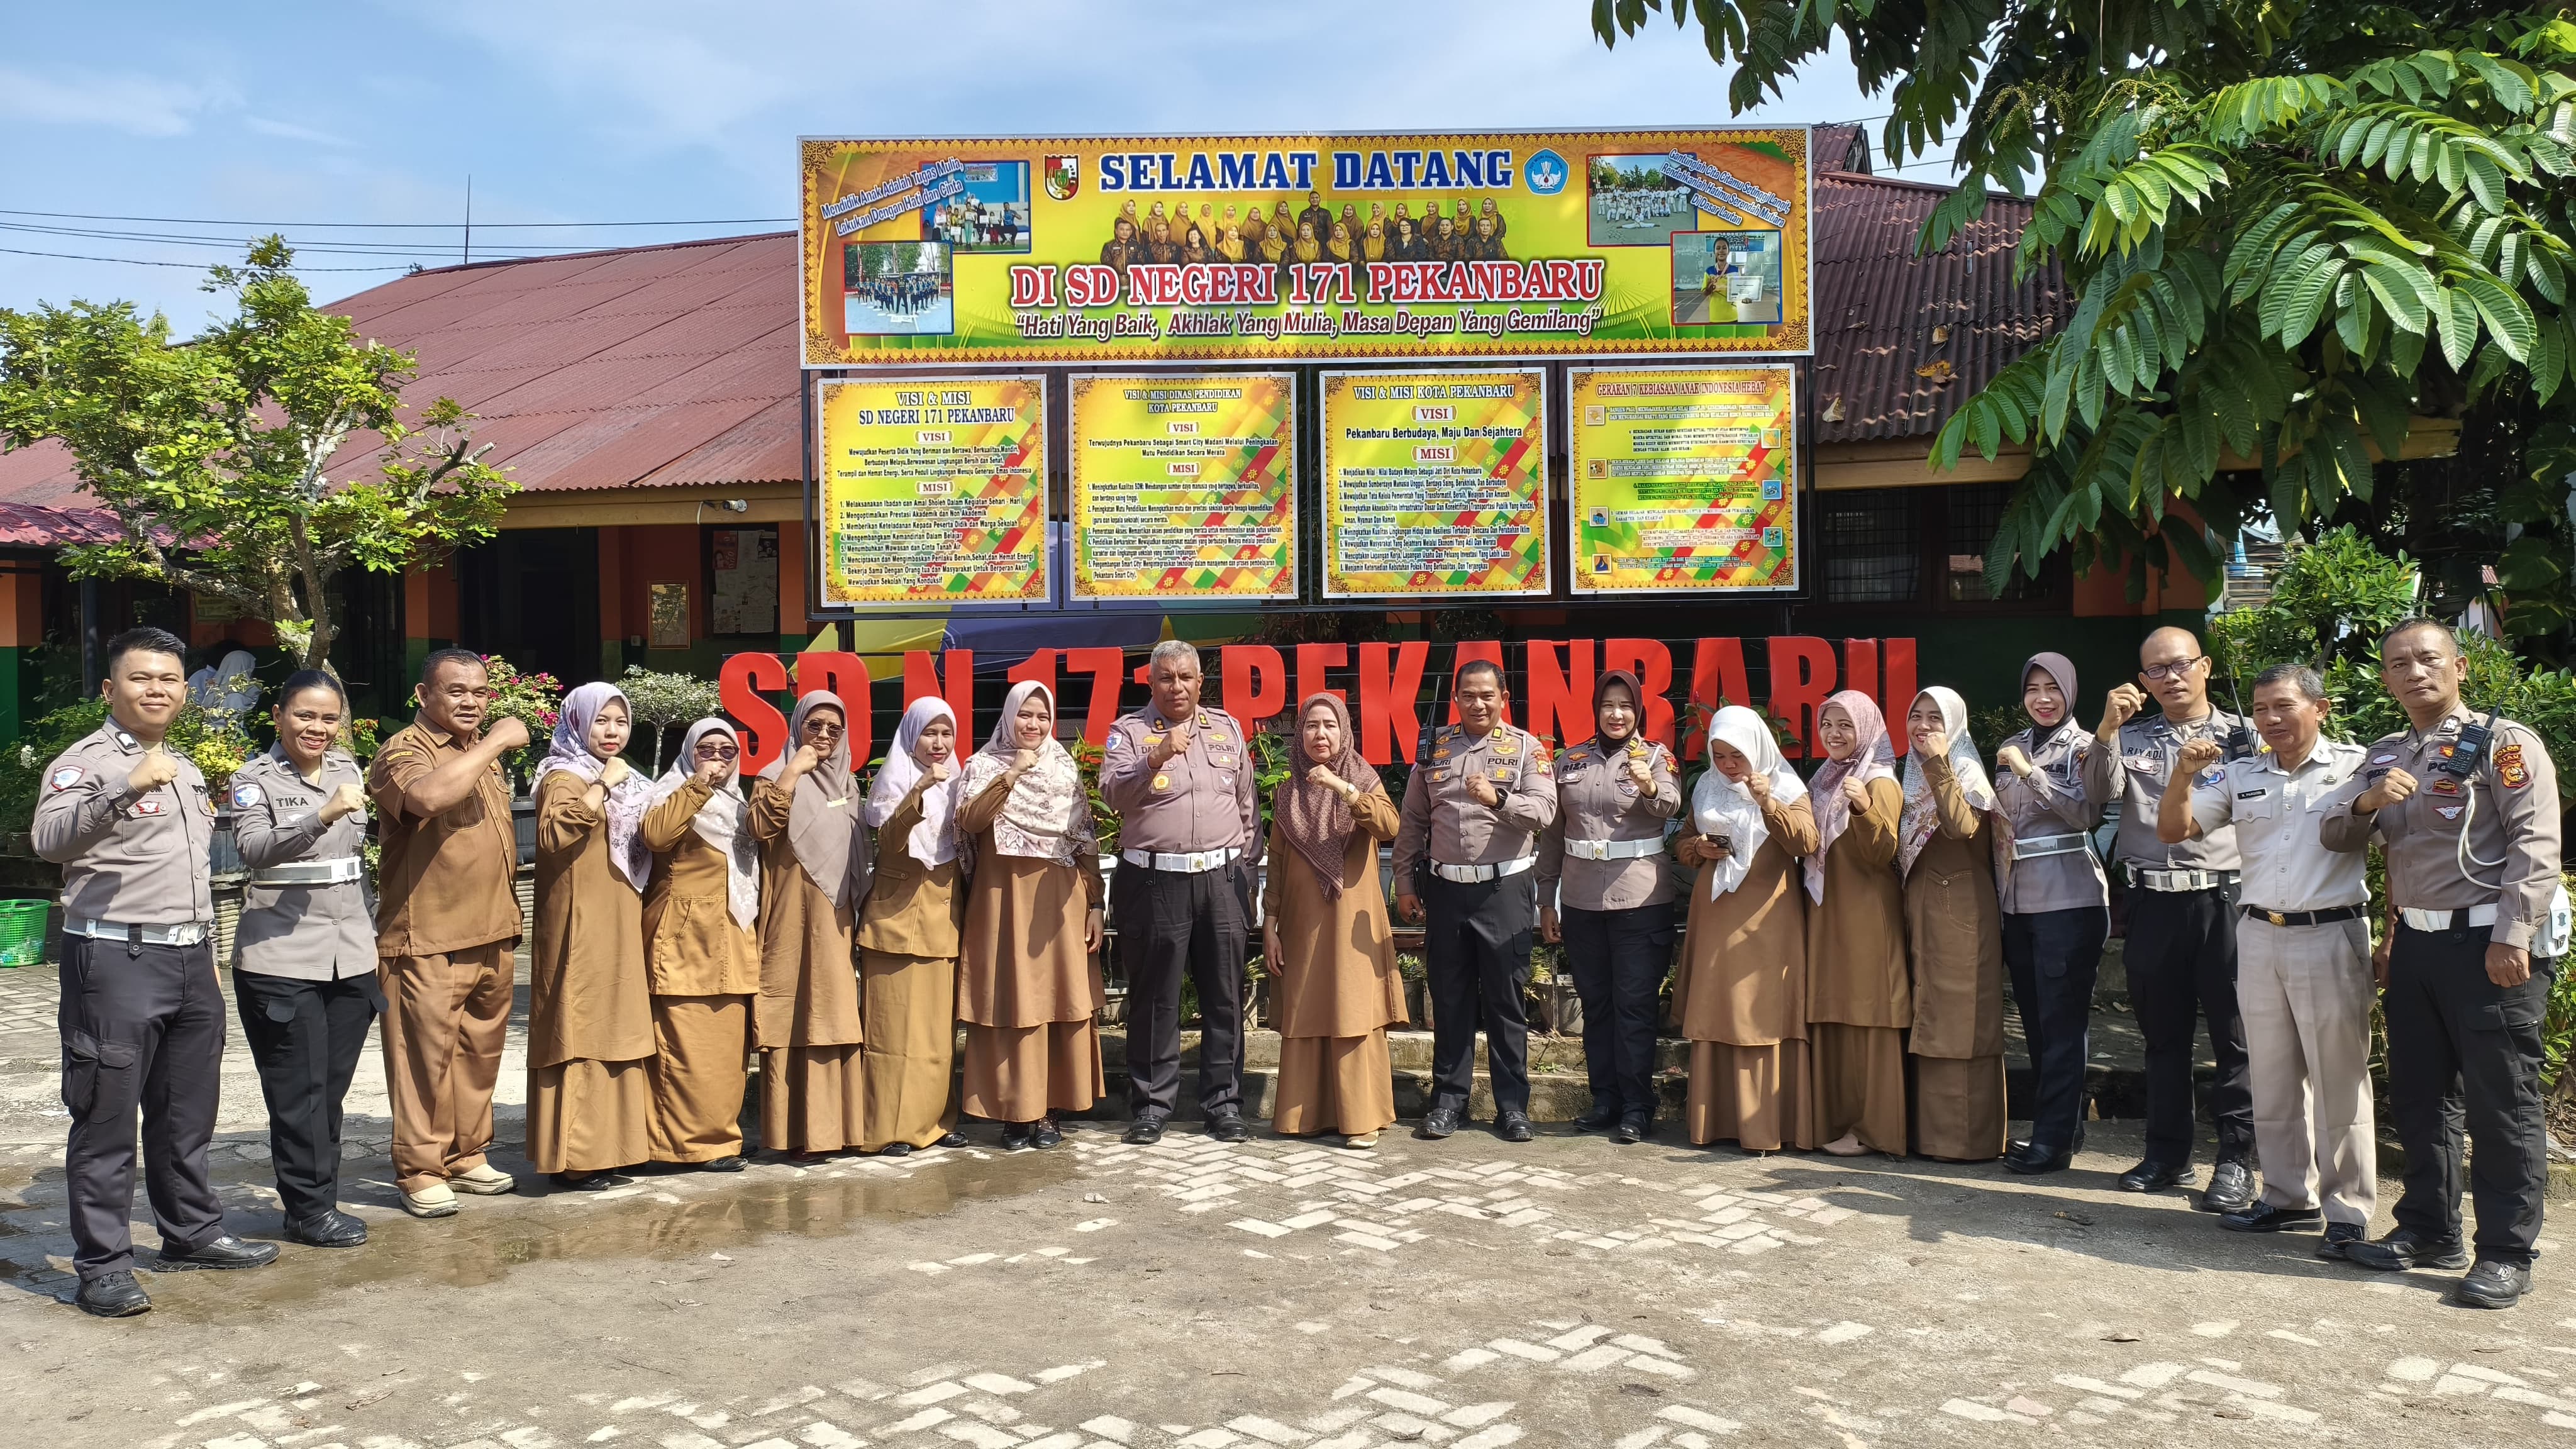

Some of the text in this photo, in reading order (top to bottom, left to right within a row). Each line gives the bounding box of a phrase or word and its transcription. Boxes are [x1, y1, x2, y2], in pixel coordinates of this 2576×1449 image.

[1101, 150, 1513, 191] SELAMAT DATANG
[821, 194, 861, 218] Mendidik
[860, 186, 882, 204] Anak
[882, 174, 912, 197] Adalah
[912, 169, 938, 185] Tugas
[936, 157, 963, 175] Mulia,
[1669, 148, 1791, 214] Gantunglah Cita Citamu Setinggi Langit,
[1661, 162, 1785, 227] Rendahkanlah Hatimu Serendah Mutiara
[835, 180, 963, 235] Lakukan Dengan Hati dan Cinta
[1690, 194, 1742, 225] Di Dasar Lautan
[1012, 260, 1603, 304] DI SD NEGERI 171 PEKANBARU
[1067, 314, 1111, 340] Yang
[1115, 314, 1158, 339] Baik,
[1168, 313, 1231, 335] Akhlak
[1236, 313, 1279, 339] Yang
[1284, 312, 1338, 338] Mulia,
[1341, 311, 1392, 333] Masa
[1394, 311, 1454, 337] Depan
[1458, 309, 1501, 336] Yang
[1123, 388, 1242, 400] VISI & MISI DINAS PENDIDIKAN
[1352, 384, 1515, 400] VISI & MISI KOTA PEKANBARU
[1596, 380, 1767, 397] GERAKAN 7 KEBIASAAN ANAK INDONESIA HEBAT
[895, 390, 972, 406] VISI & MISI
[1147, 402, 1218, 414] KOTA PEKANBARU
[1419, 408, 1449, 419] VISI
[859, 408, 1014, 425] SD NEGERI 171 PEKANBARU
[1173, 423, 1194, 432] VISI
[1346, 426, 1523, 441] Pekanbaru Berbudaya, Maju Dan Sejahtera
[923, 432, 945, 441] VISI
[1089, 439, 1122, 448] Terwujudnya
[1153, 438, 1174, 447] Sebagai
[1192, 438, 1204, 447] City
[1245, 438, 1278, 447] Peningkatan
[1420, 448, 1450, 460] MISI
[1172, 464, 1195, 473] MISI
[923, 483, 947, 492] MISI
[847, 511, 889, 521] Mengoptimalkan
[913, 509, 938, 518] Akademik
[962, 508, 987, 516] Akademik
[847, 522, 878, 530] Memberikan
[879, 521, 912, 530] Keteladanan
[913, 521, 931, 531] Kepada
[933, 520, 953, 528] Peserta
[979, 519, 996, 529] Warga
[997, 518, 1018, 527] Sekolah
[848, 567, 867, 575] Bekerja
[884, 566, 904, 575] Dengan
[904, 565, 921, 575] Orang
[942, 564, 972, 574] Masyarakat
[990, 564, 1014, 573] Berperan
[1015, 563, 1028, 571] Aktif
[719, 650, 873, 777] SD
[903, 648, 974, 769] N
[1208, 743, 1236, 753] POLRI
[1428, 758, 1452, 769] AJRI
[1487, 758, 1518, 766] POLRI
[1562, 762, 1588, 772] RIZA
[275, 796, 309, 808] TIKA
